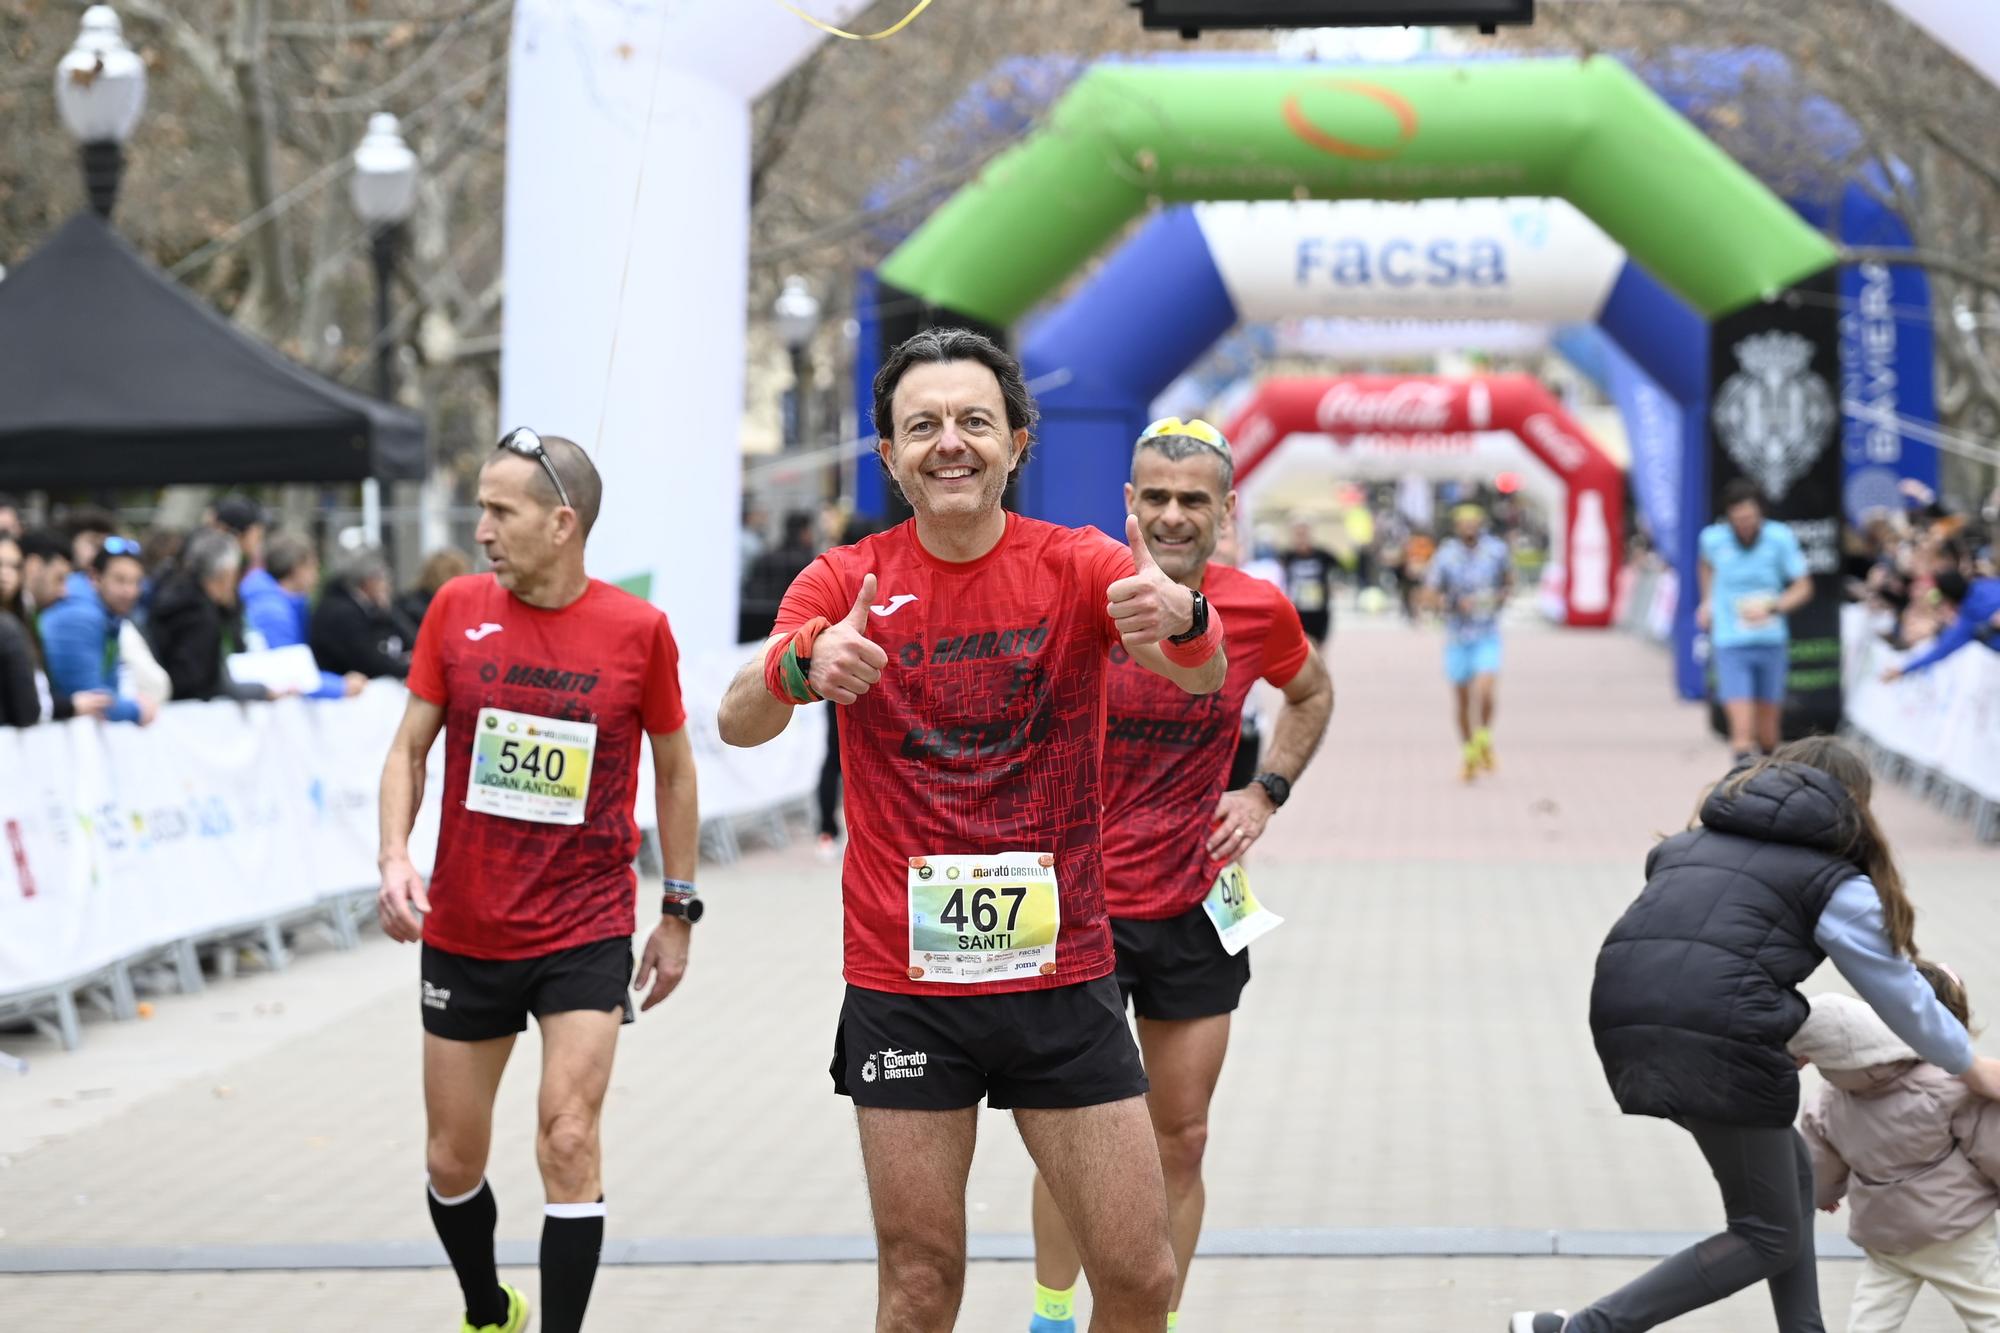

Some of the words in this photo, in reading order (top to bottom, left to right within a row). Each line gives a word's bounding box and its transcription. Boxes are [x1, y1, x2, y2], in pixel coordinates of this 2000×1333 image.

[930, 616, 1048, 664] MARATÓ
[499, 740, 565, 781] 540
[481, 772, 519, 789] JOAN
[521, 779, 577, 799] ANTONI
[940, 886, 1027, 933] 467
[958, 934, 1011, 950] SANTI
